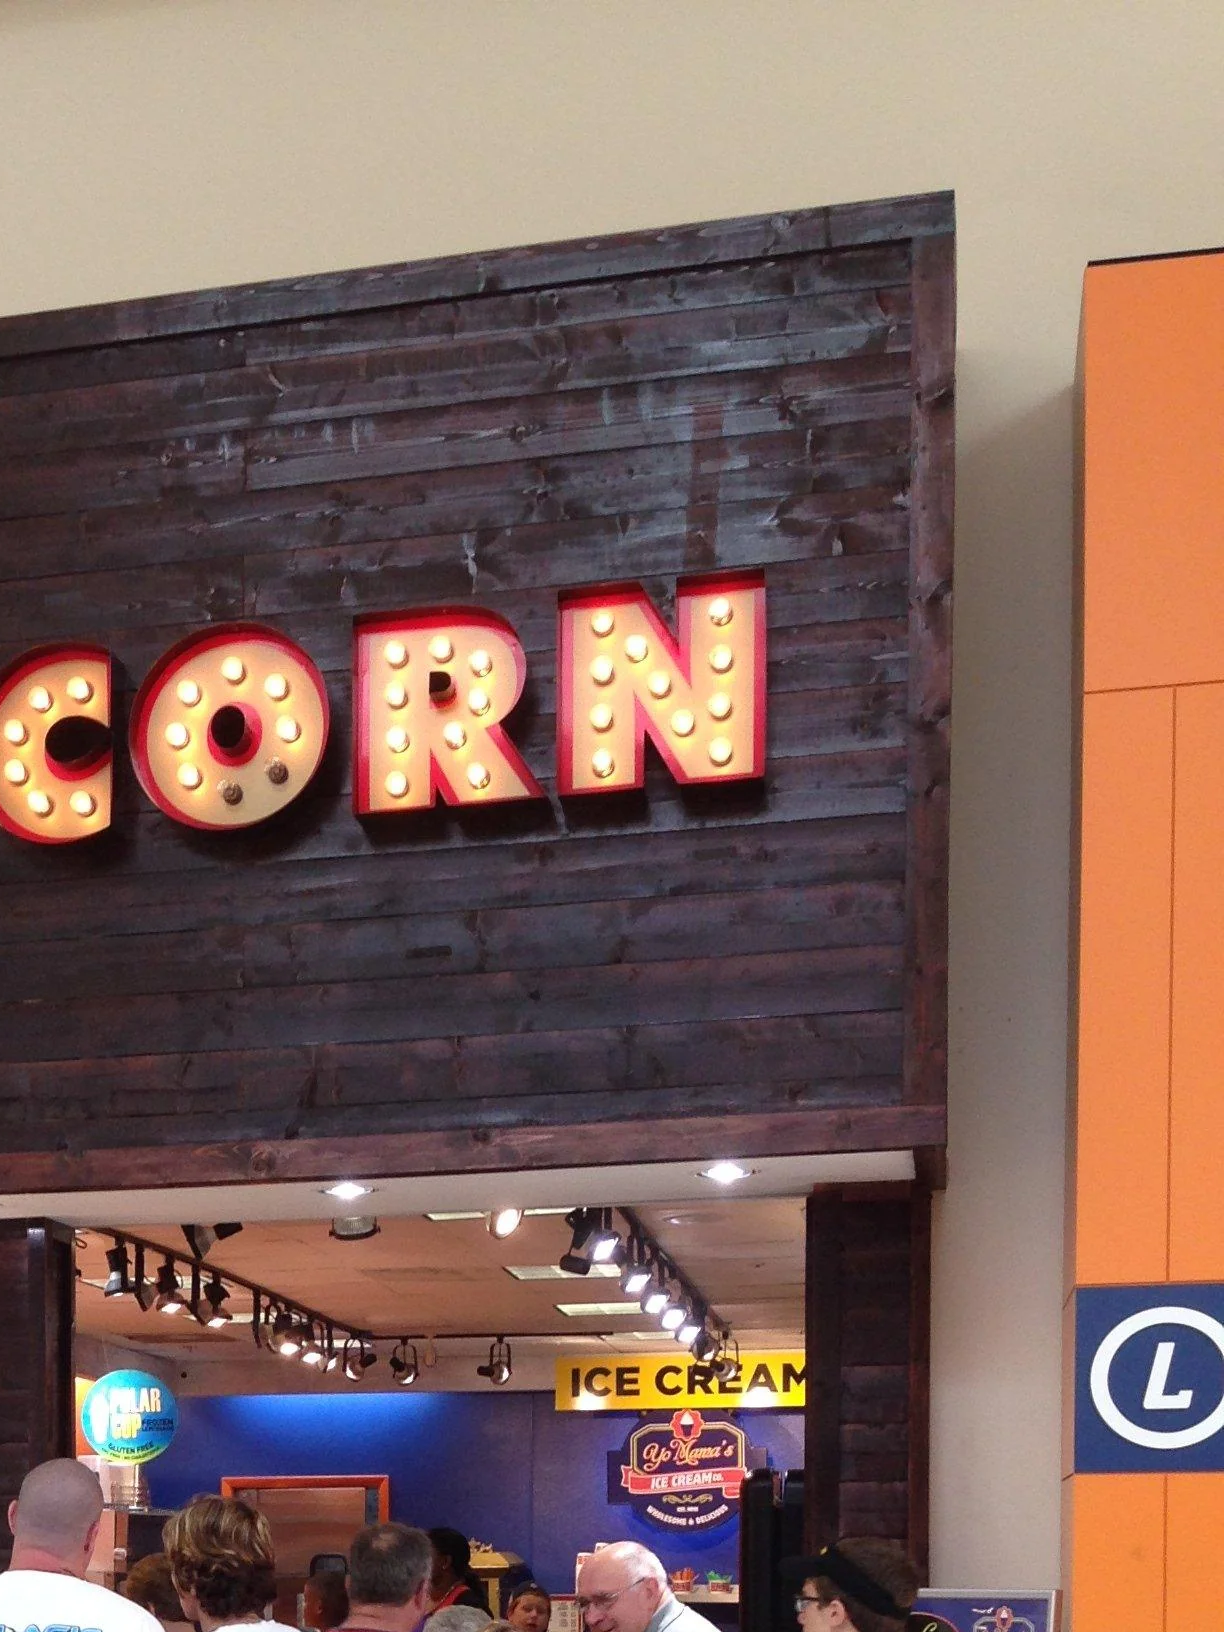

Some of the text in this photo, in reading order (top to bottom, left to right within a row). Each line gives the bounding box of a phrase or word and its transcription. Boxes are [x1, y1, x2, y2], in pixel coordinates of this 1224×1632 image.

[571, 1366, 640, 1397] ICE
[1143, 1341, 1194, 1410] L
[109, 1387, 162, 1413] PLAR
[108, 1442, 136, 1454] GLUTEN
[642, 1438, 736, 1472] Yo Mama's
[650, 1475, 669, 1490] ICE
[672, 1472, 712, 1487] CREAM
